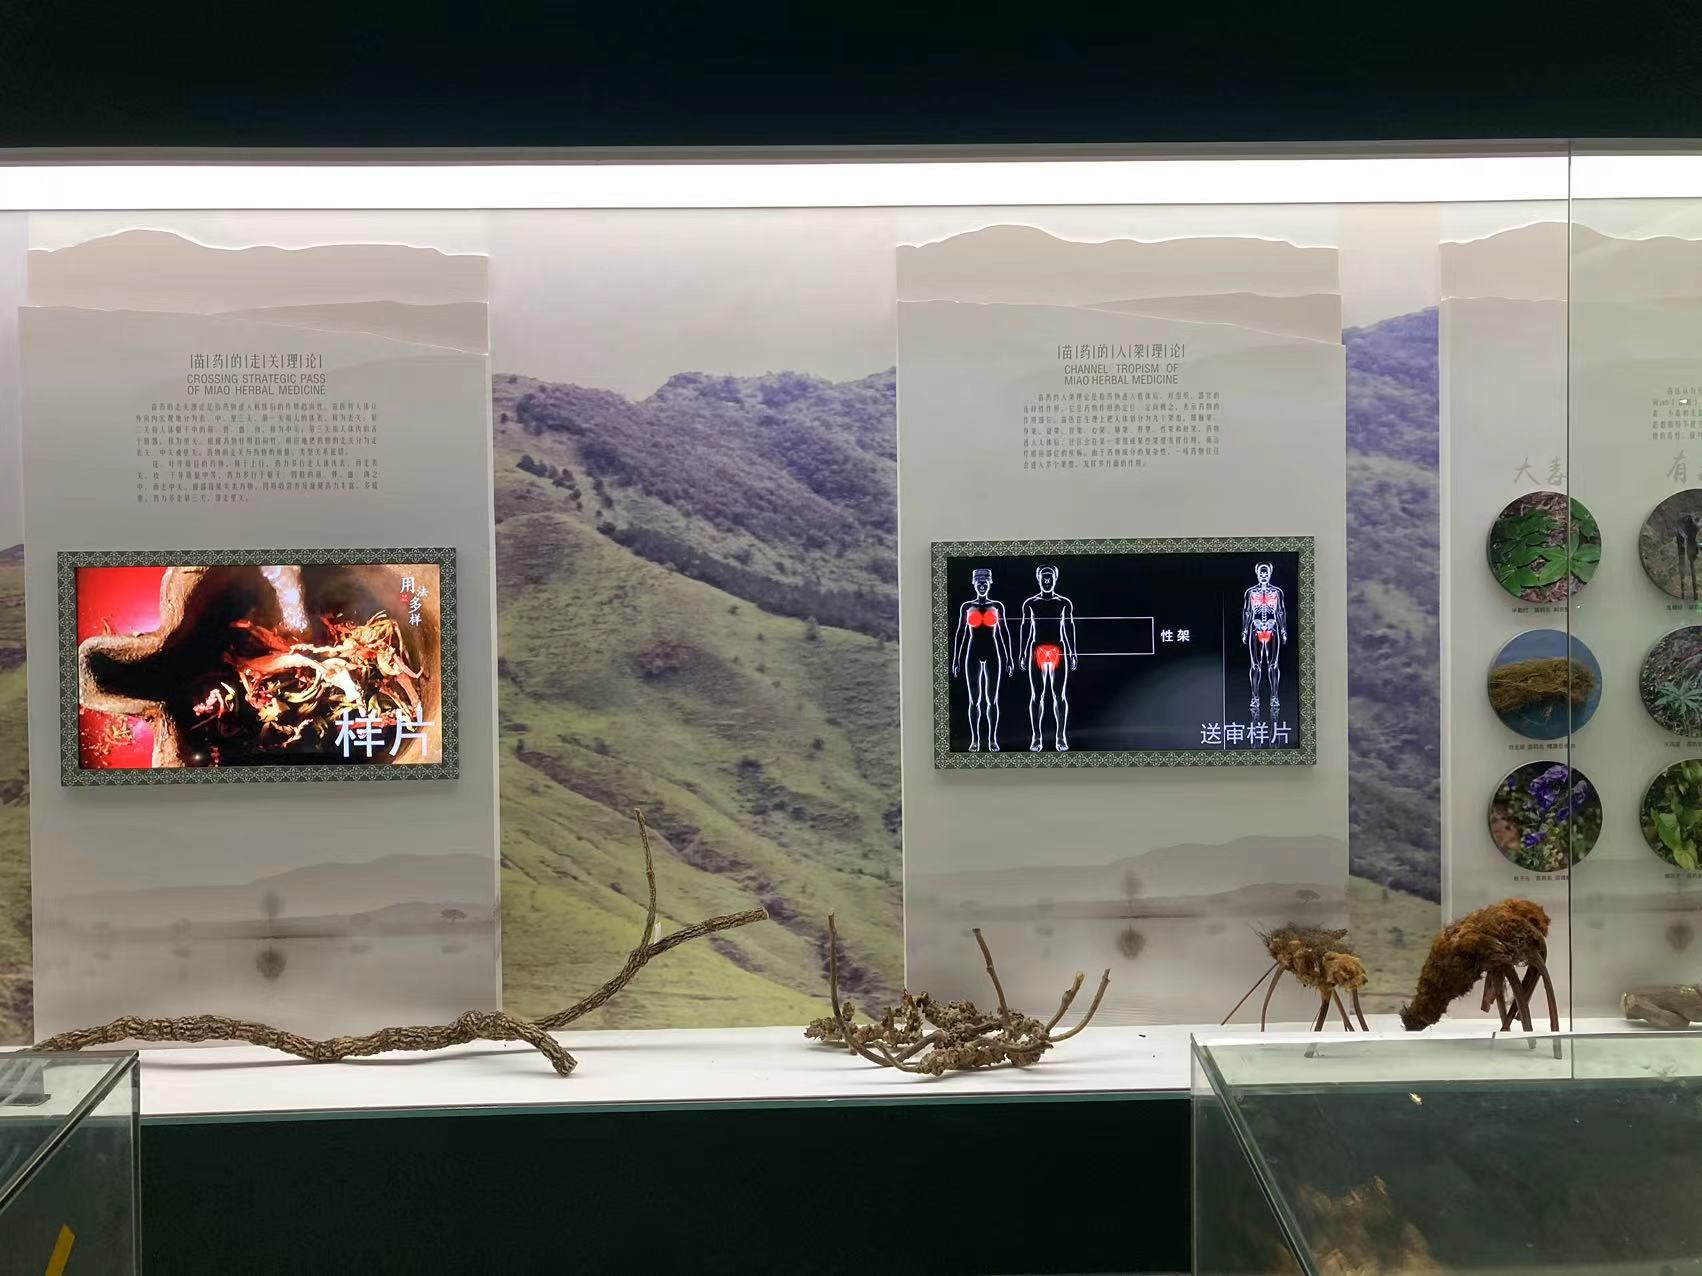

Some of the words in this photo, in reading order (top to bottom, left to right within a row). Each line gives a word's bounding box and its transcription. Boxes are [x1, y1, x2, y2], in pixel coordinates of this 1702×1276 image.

[1064, 364, 1109, 375] CHANNEL
[1116, 363, 1160, 374] TROPISM
[1166, 363, 1179, 374] OF
[187, 374, 238, 384] CROSSING
[242, 374, 296, 384] STRATEGIC
[300, 374, 327, 383] PASS
[1064, 375, 1090, 386] MIAO
[1091, 375, 1130, 385] HERBAL
[1131, 375, 1179, 385] MEDICINE
[187, 385, 199, 396] OF
[204, 385, 231, 396] MIAO
[235, 385, 274, 396] HERBAL
[278, 385, 327, 395] MEDICINE
[1160, 629, 1191, 644] 性架
[334, 705, 436, 759] 样片
[1199, 722, 1293, 746] 送审样片
